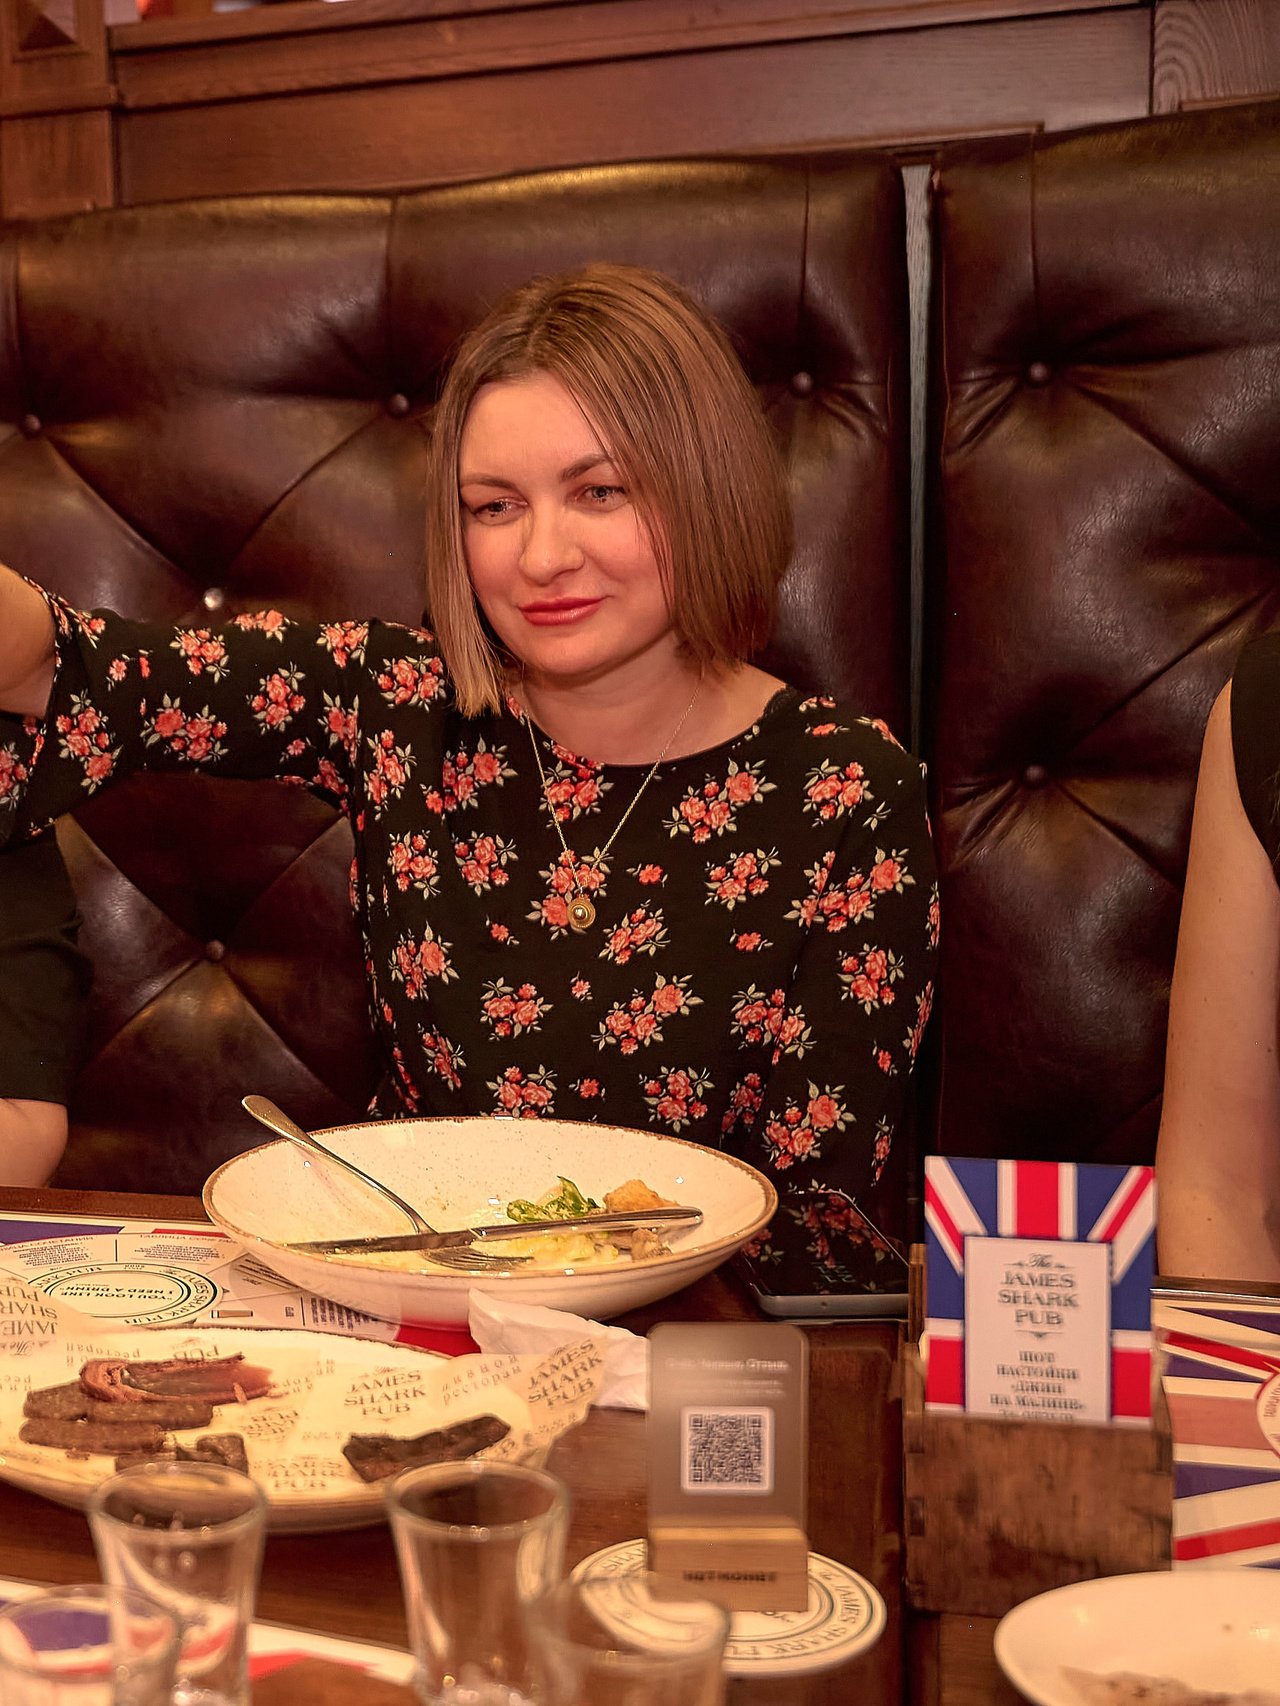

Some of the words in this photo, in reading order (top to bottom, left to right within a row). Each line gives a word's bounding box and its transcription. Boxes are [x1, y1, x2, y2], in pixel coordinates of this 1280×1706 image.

[1028, 1253, 1052, 1268] The
[1000, 1271, 1074, 1288] JAMES
[998, 1289, 1079, 1308] SHARK
[1015, 1310, 1063, 1325] PUB
[66, 1343, 141, 1360] ресторан
[528, 1339, 594, 1390] JAMES
[996, 1363, 1079, 1380] НАСТОЙКИ
[347, 1369, 422, 1394] JAMES
[528, 1351, 602, 1403] SHARK
[343, 1386, 426, 1406] SHARK
[547, 1378, 594, 1406] PUB
[990, 1394, 1011, 1405] НА
[360, 1402, 411, 1416] PUB
[833, 1584, 860, 1625] JAMES
[772, 1626, 848, 1655] SHARK
